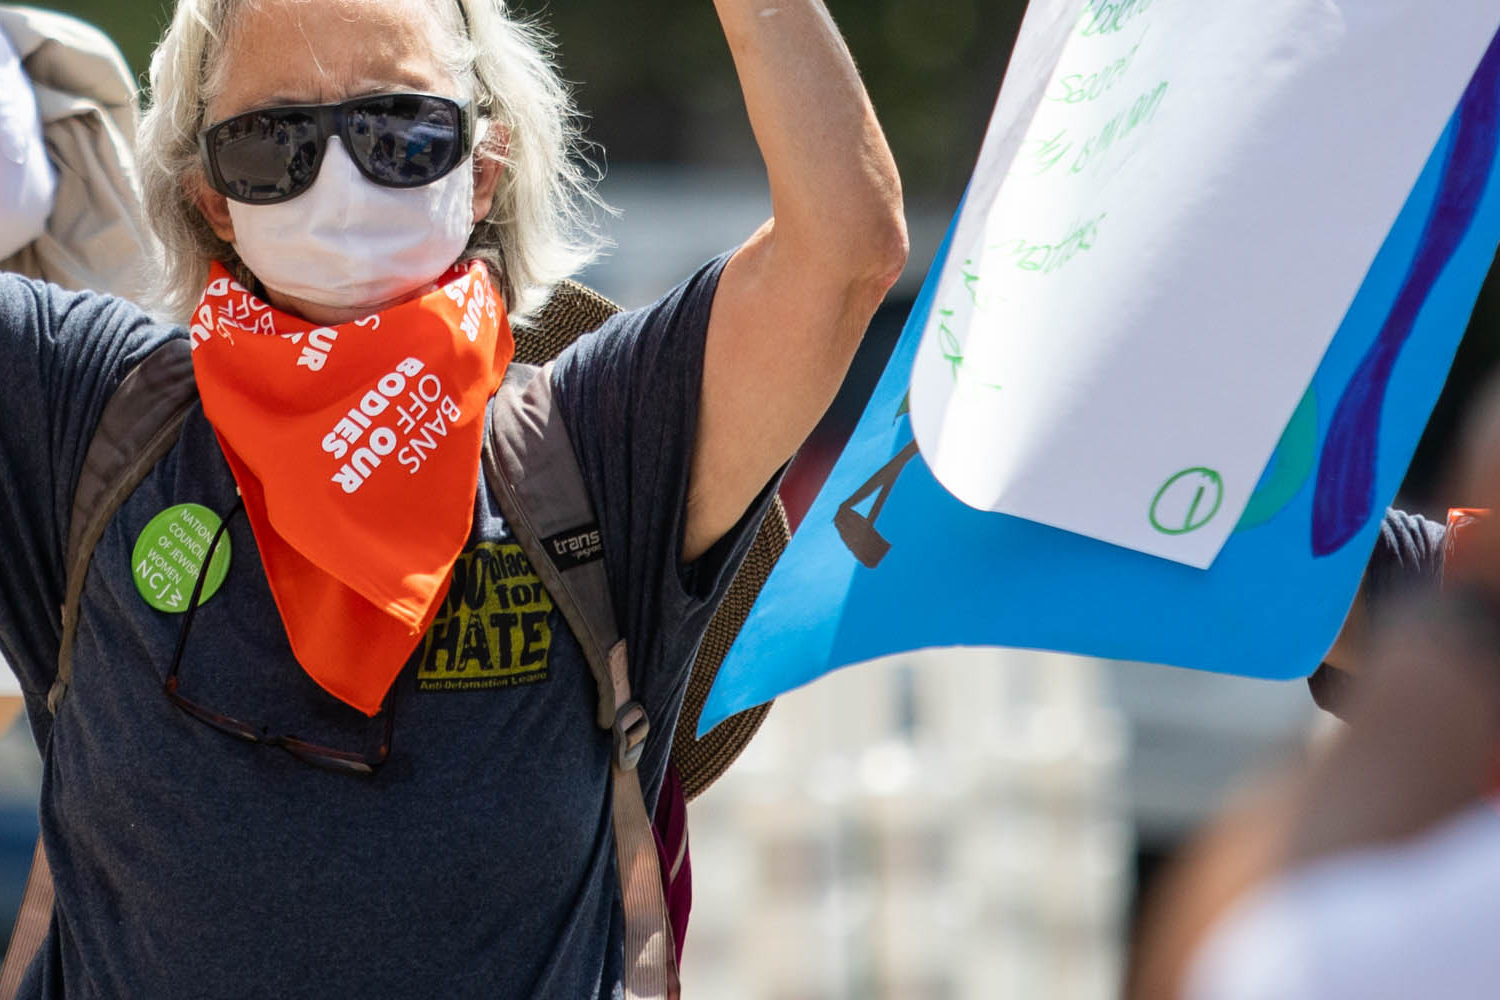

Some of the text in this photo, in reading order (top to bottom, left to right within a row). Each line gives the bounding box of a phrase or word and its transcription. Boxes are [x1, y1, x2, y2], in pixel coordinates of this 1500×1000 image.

[297, 326, 338, 372] UR
[321, 356, 425, 460] BODIES
[331, 373, 442, 495] OFF OUR
[397, 394, 462, 475] BANS
[168, 523, 206, 560] COUNCIL
[179, 509, 223, 553] NATIONL
[147, 548, 182, 584] WOMEN
[157, 535, 202, 581] OF JEWISH
[489, 550, 537, 584] plac
[136, 559, 183, 607] NCJW
[494, 581, 544, 610] for
[424, 609, 550, 673] HATE
[419, 678, 509, 691] Anti-Defamation
